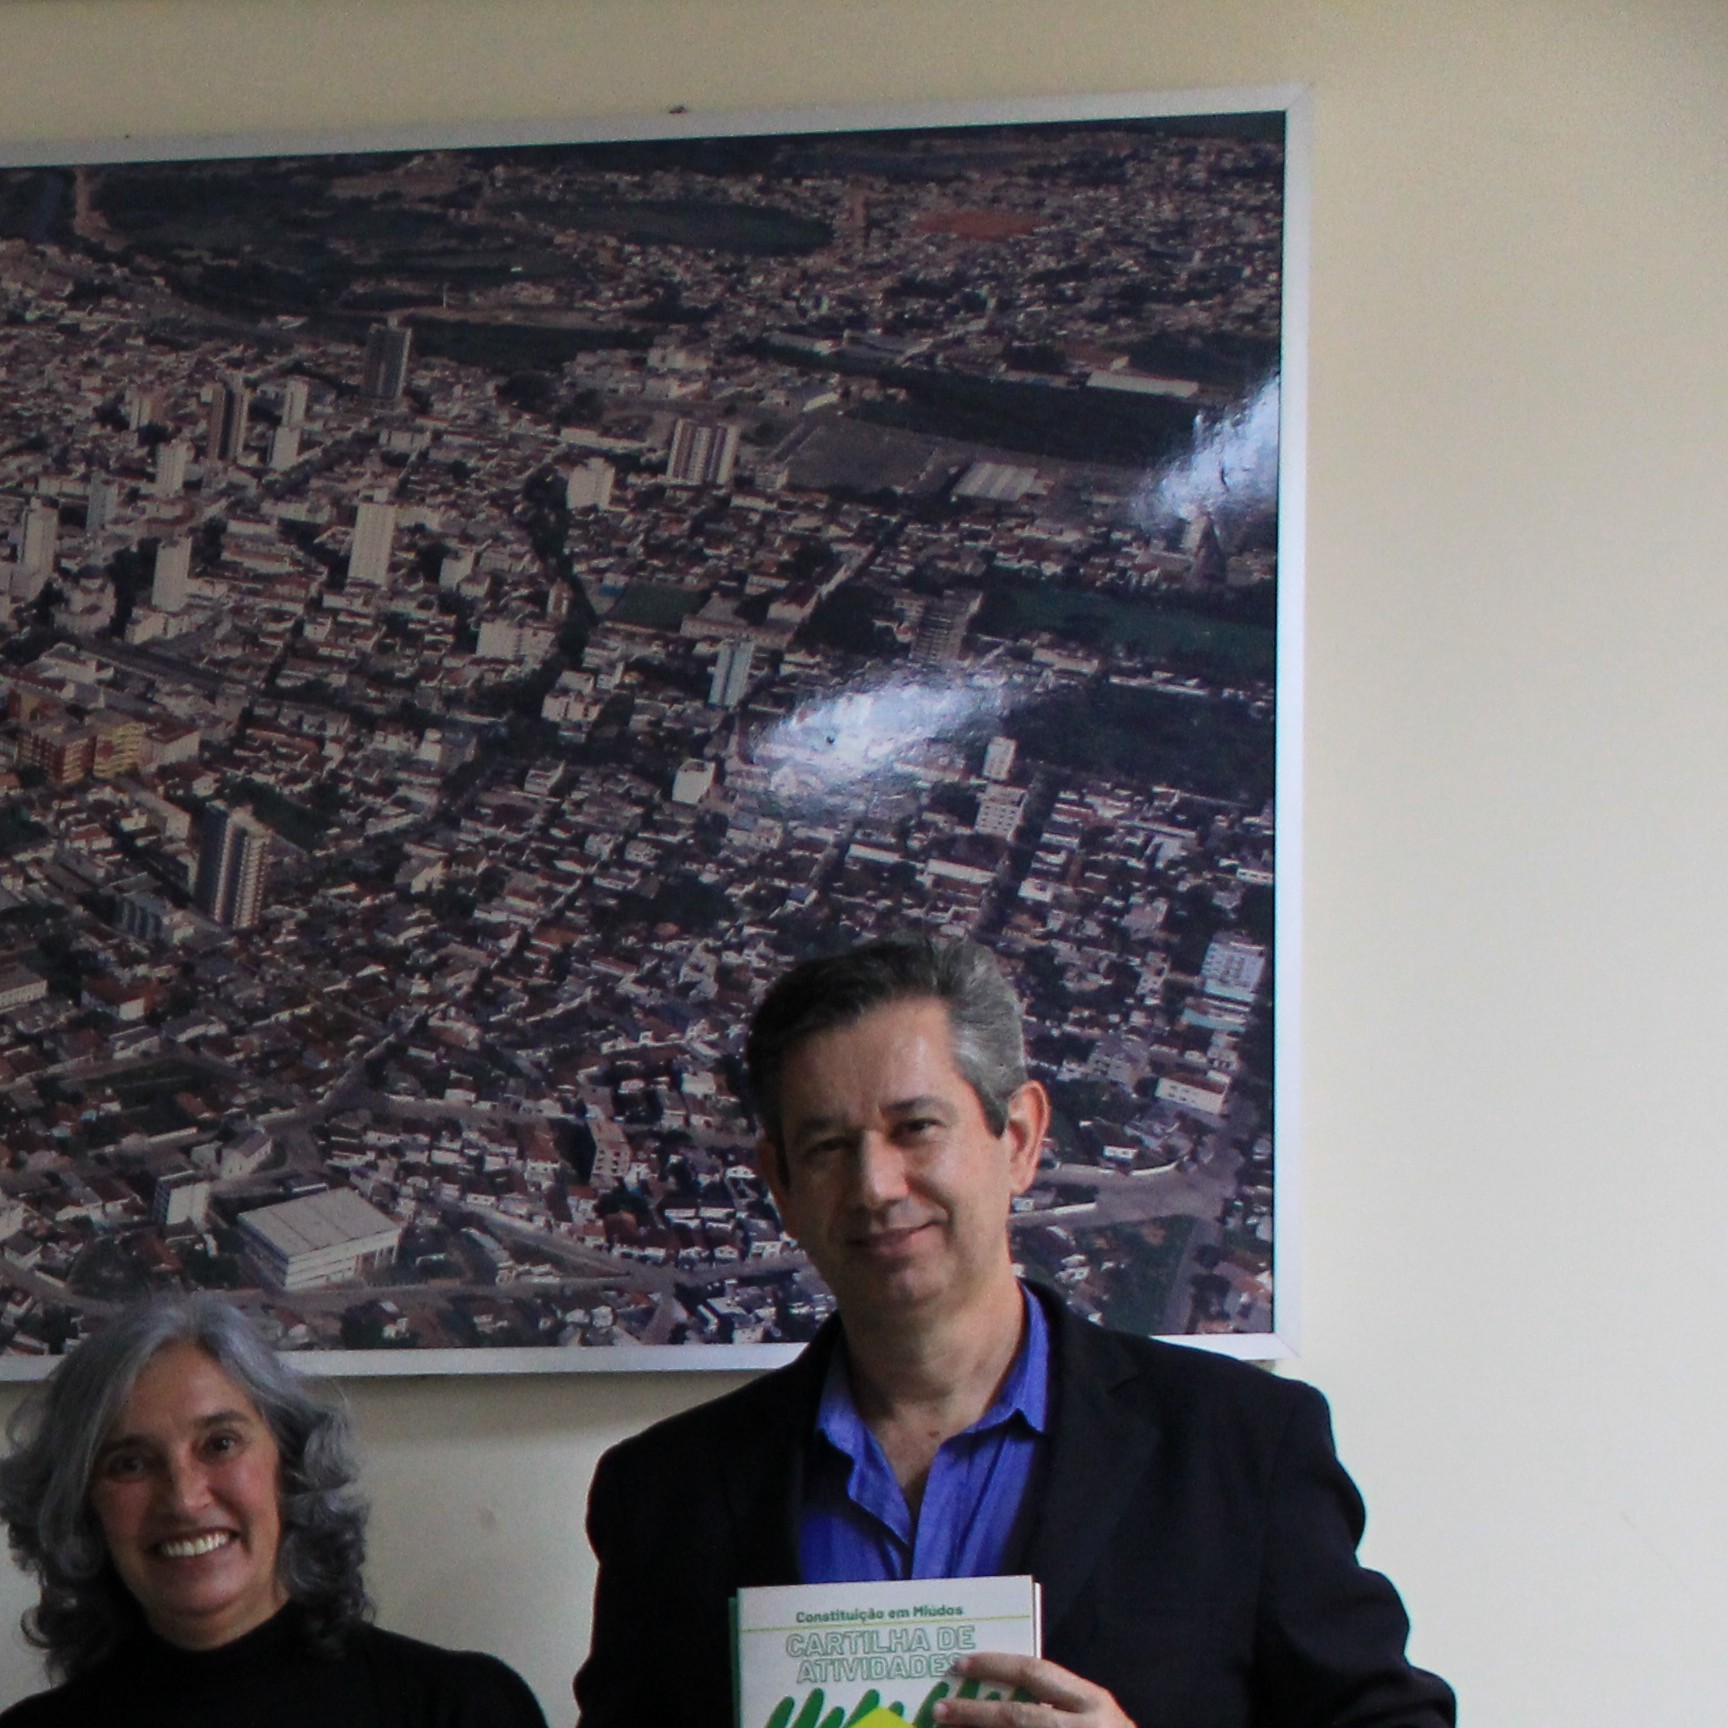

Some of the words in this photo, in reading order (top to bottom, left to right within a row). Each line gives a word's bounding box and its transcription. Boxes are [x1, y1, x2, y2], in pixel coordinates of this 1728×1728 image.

[888, 1608, 910, 1619] em
[785, 1628, 930, 1658] CARTILHA
[937, 1625, 976, 1650] DE
